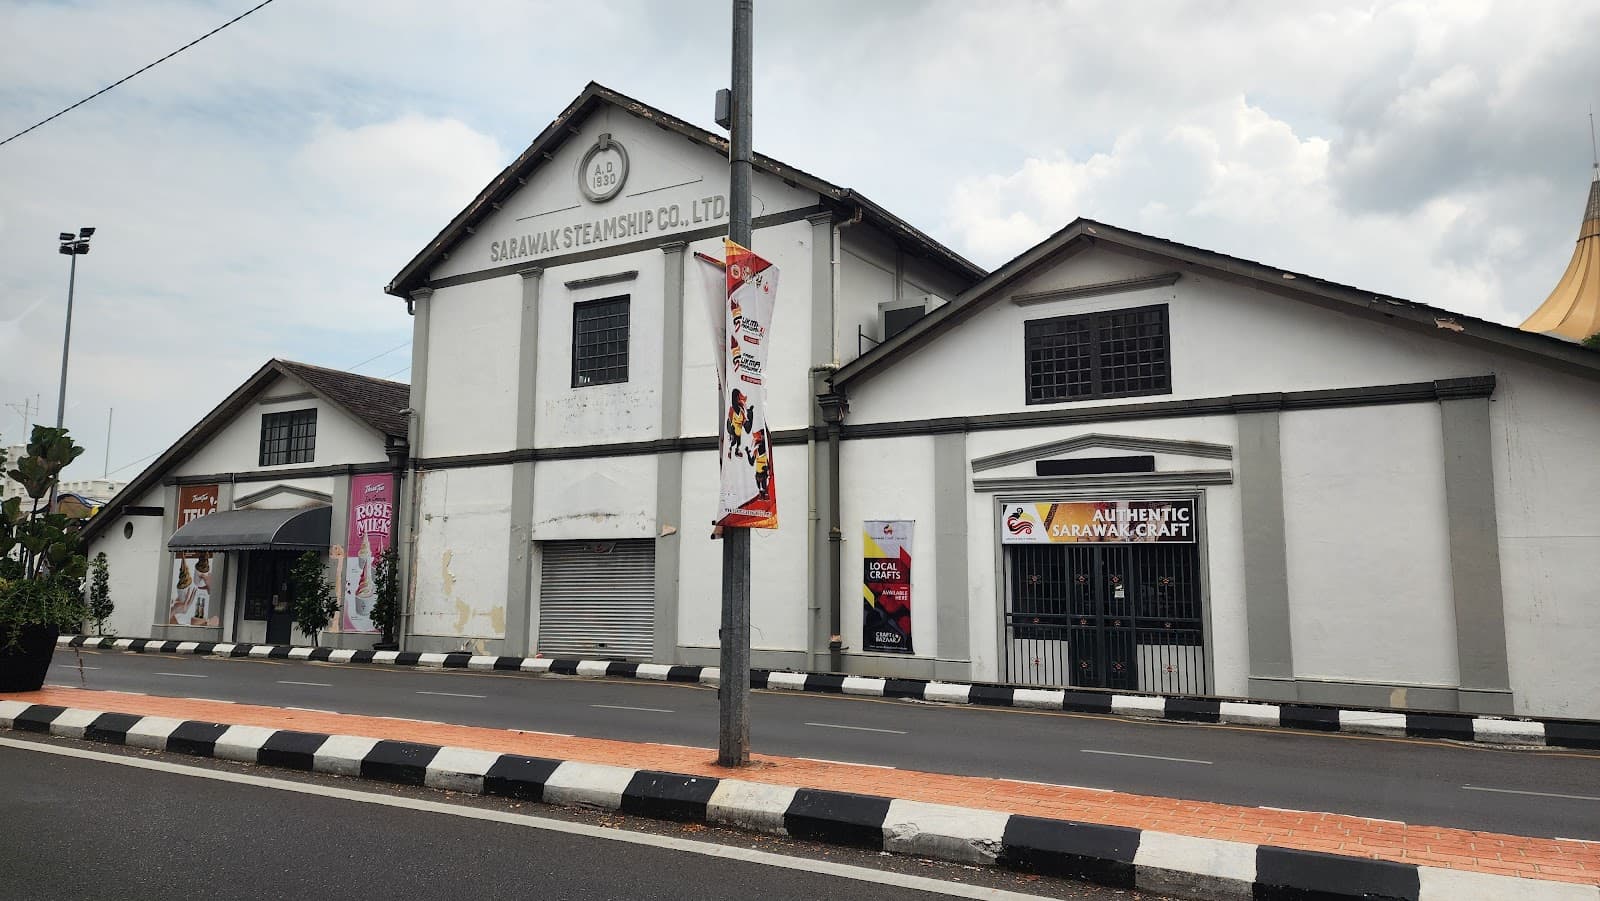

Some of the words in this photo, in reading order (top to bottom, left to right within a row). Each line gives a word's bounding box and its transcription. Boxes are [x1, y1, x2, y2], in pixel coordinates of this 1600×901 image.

[490, 228, 560, 262] SARAWAK
[563, 209, 654, 249] STEAMSHIP
[656, 204, 689, 231] CO.,
[692, 194, 730, 223] LTD.
[355, 501, 392, 519] ROSE
[1091, 507, 1190, 522] AUTHENTIC
[356, 518, 391, 537] MILK
[1052, 523, 1130, 537] SARAWAK
[1135, 523, 1190, 537] CRAFT
[869, 562, 898, 571] LOCAL
[869, 570, 901, 580] CRAFTS
